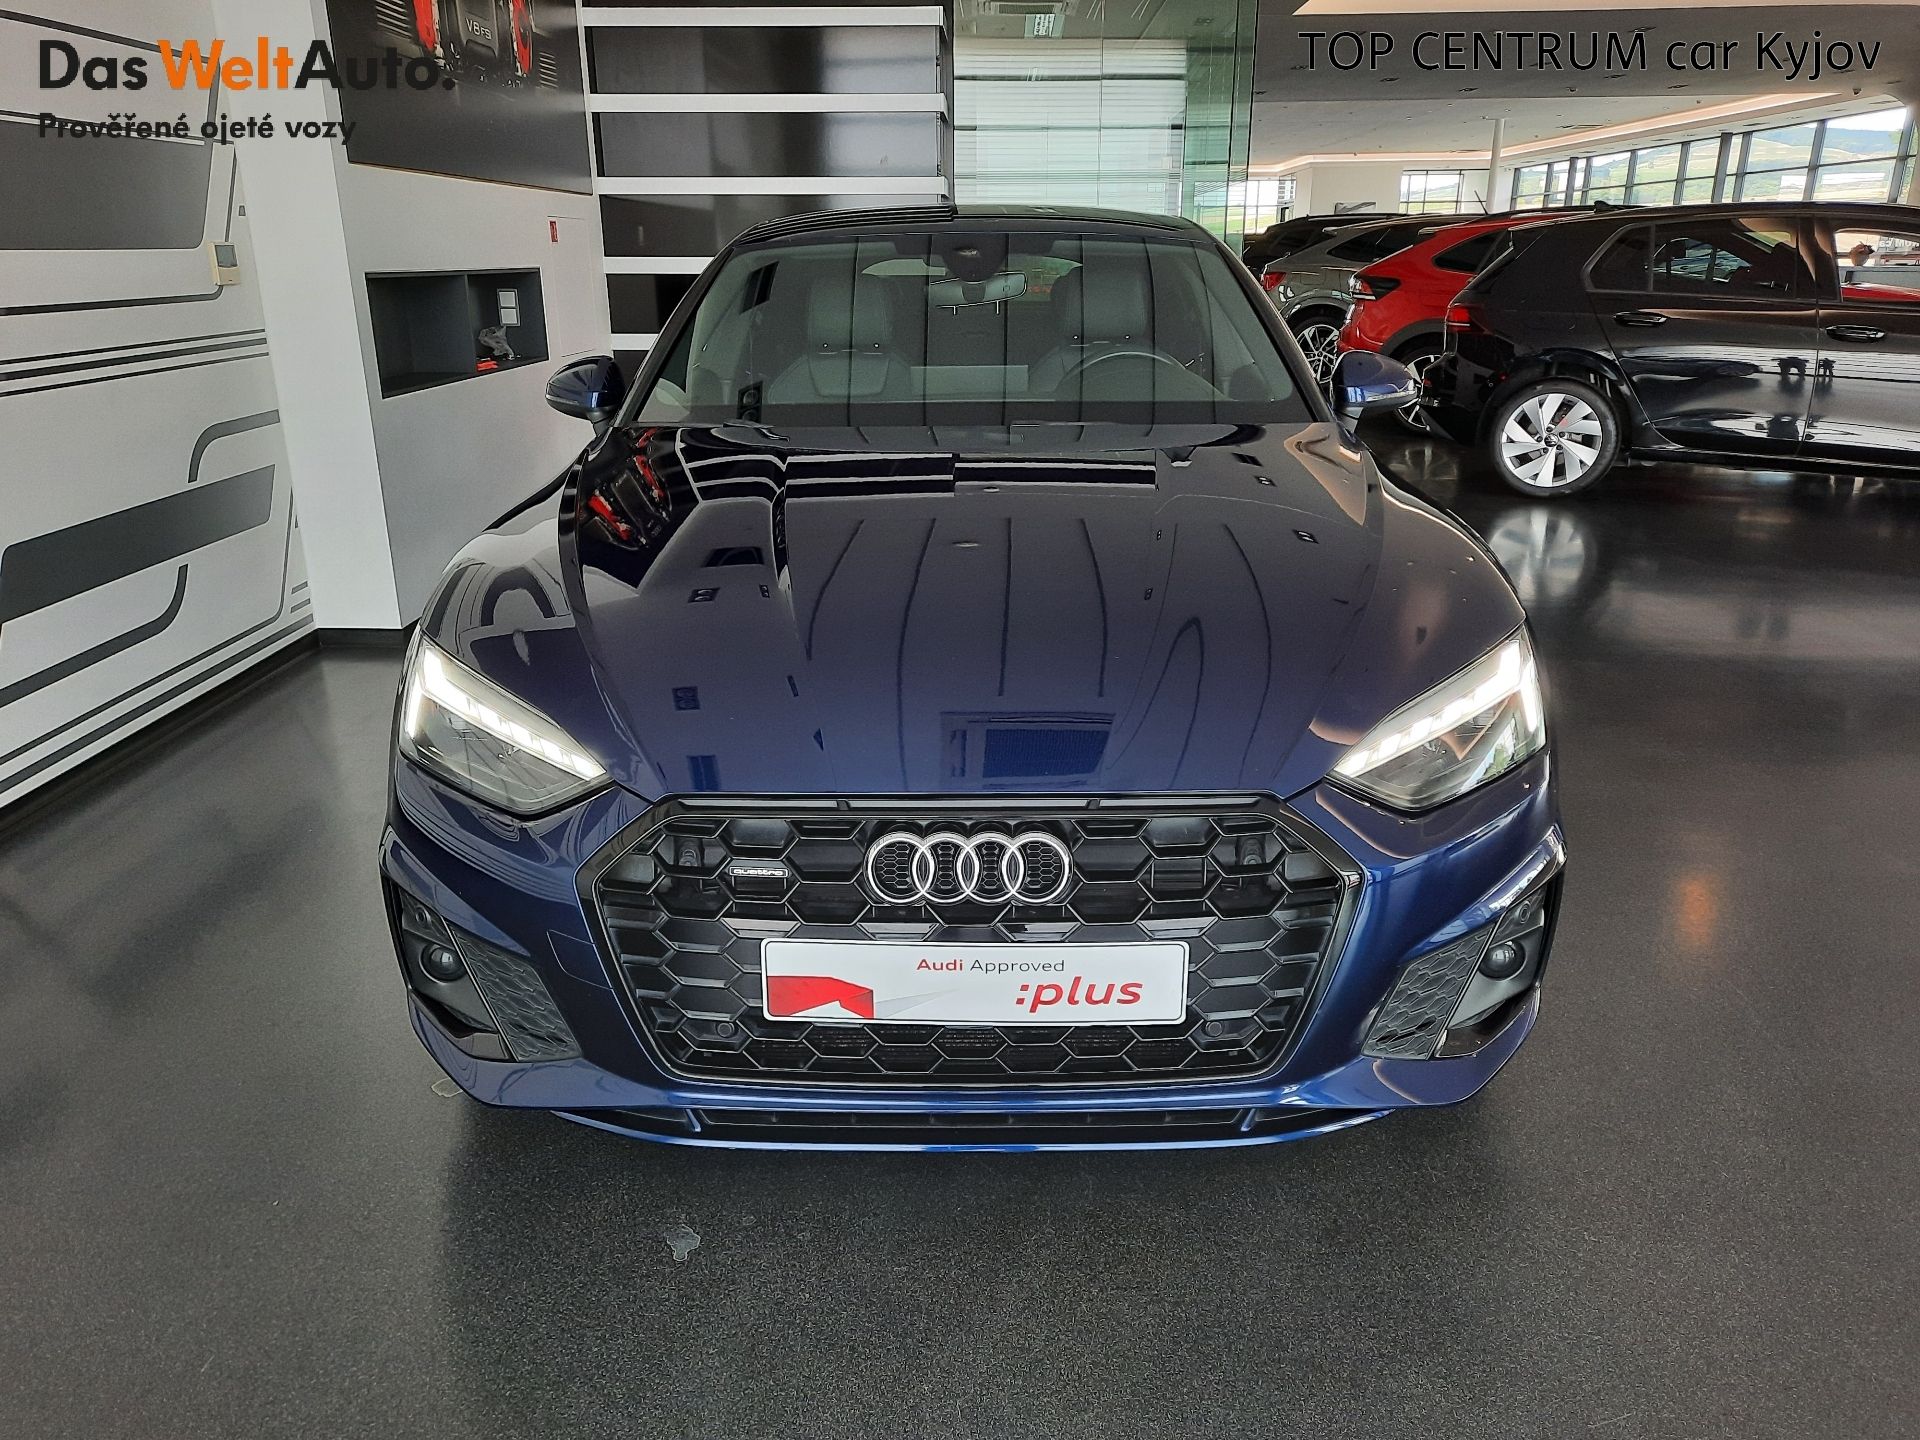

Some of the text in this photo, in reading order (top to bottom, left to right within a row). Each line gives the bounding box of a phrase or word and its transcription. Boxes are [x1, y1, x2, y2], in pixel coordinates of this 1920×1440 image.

[733, 868, 784, 876] quattro
[916, 958, 1065, 975] Audi Approved
